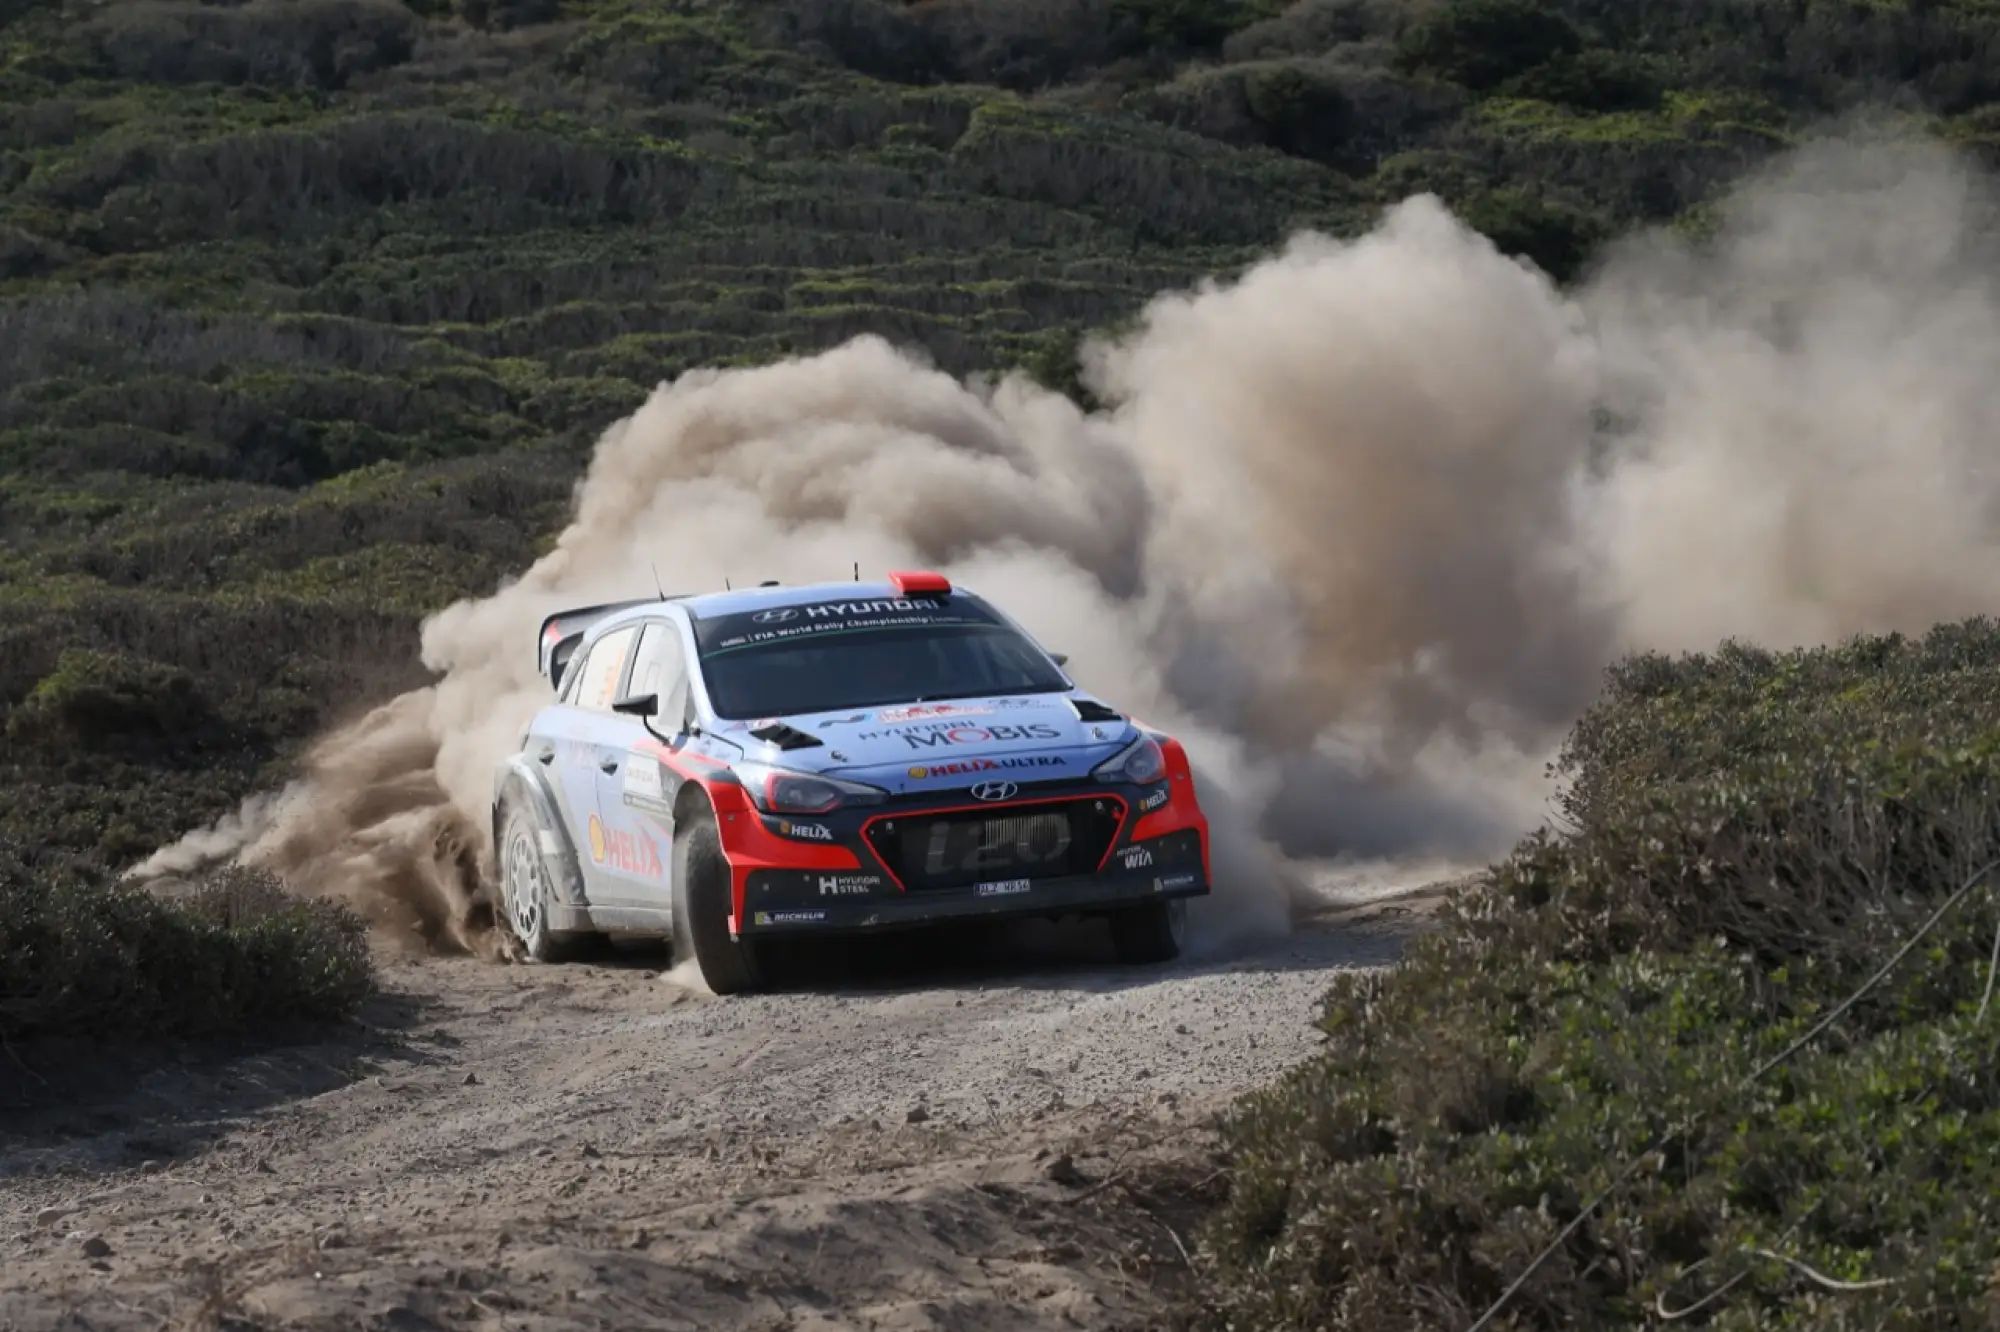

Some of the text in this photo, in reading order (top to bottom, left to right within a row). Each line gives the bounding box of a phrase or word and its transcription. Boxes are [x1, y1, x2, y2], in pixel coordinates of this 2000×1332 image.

[806, 599, 940, 617] HYUNDAI
[754, 631, 776, 641] FIA
[777, 626, 812, 637] World
[814, 621, 843, 632] Rally
[847, 615, 929, 629] Championship
[858, 720, 976, 740] HYUNDAI
[903, 724, 1061, 749] MOBIS
[930, 755, 1067, 777] HELIX ULTRA
[1147, 789, 1168, 810] HELIX
[791, 823, 834, 840] HELIX
[603, 820, 664, 878] HELIX
[774, 911, 826, 922] MICHELIN
